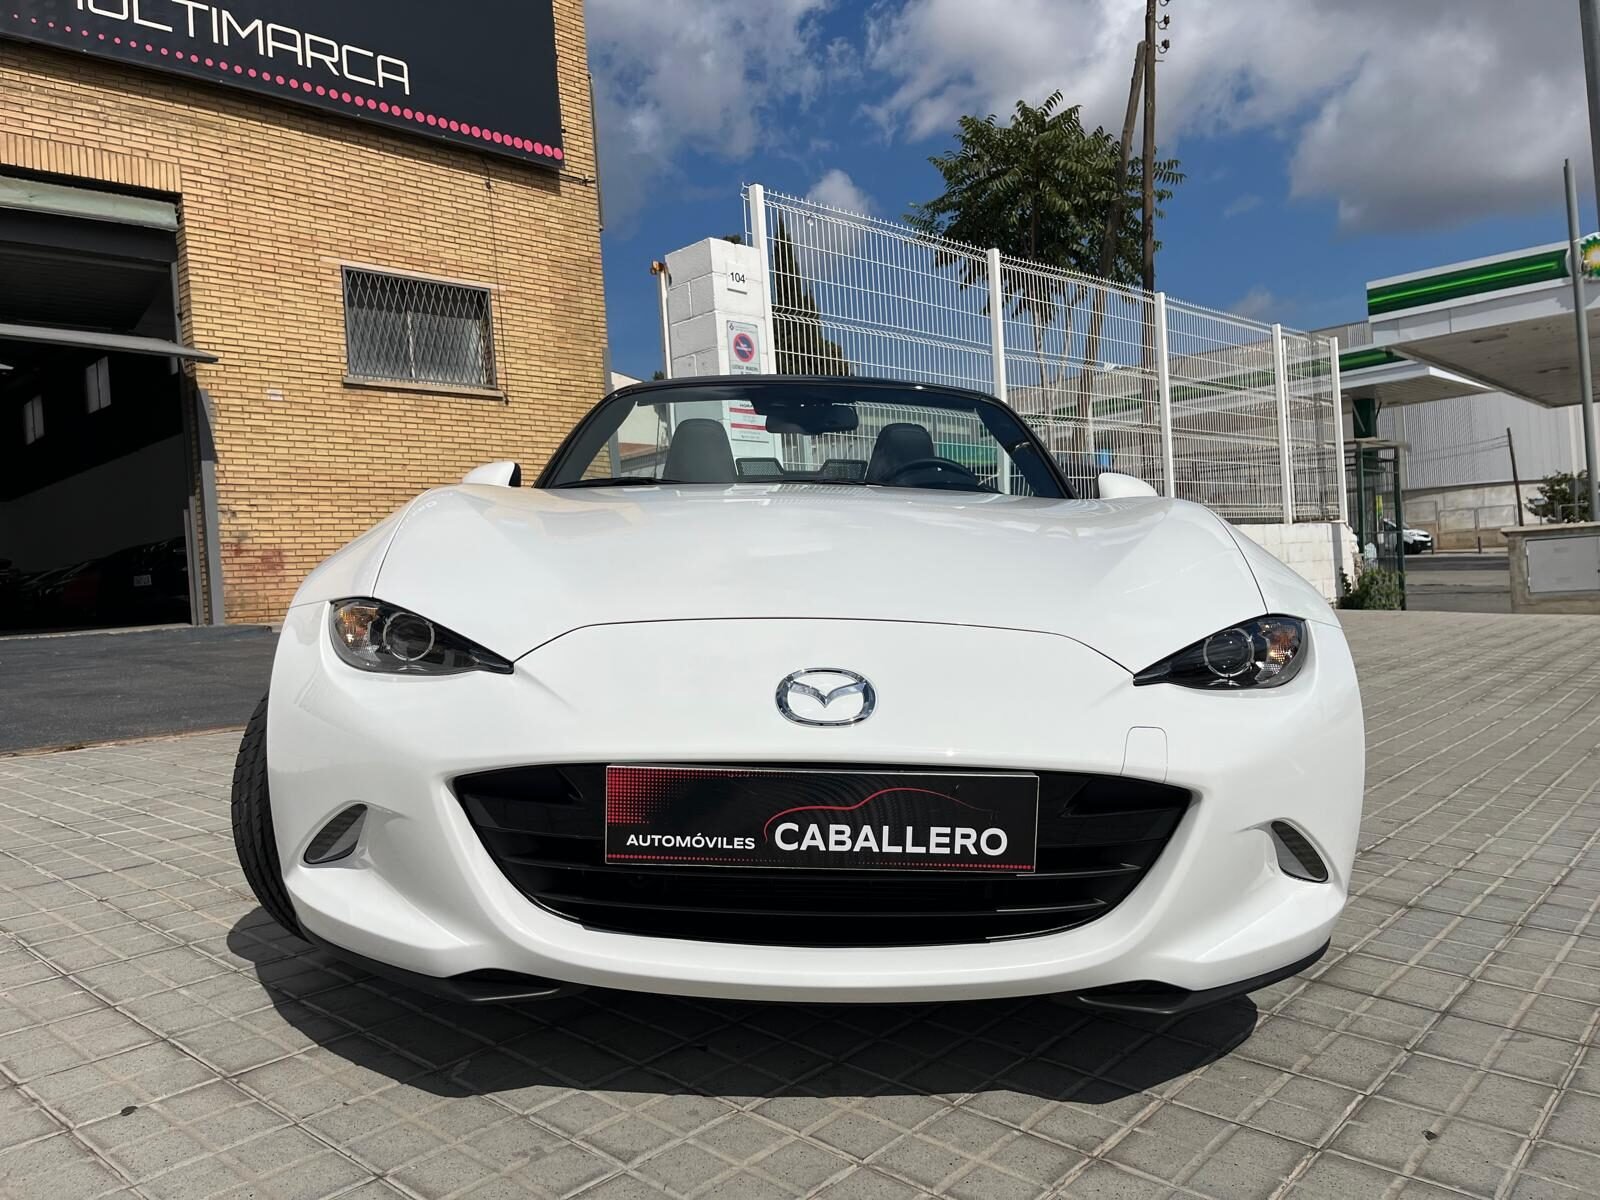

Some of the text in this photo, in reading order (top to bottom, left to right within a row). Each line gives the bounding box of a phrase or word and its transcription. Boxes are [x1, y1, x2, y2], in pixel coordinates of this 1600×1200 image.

[730, 271, 746, 284] 104
[626, 822, 1009, 856] AUTOMÓVILES CABALLERO
